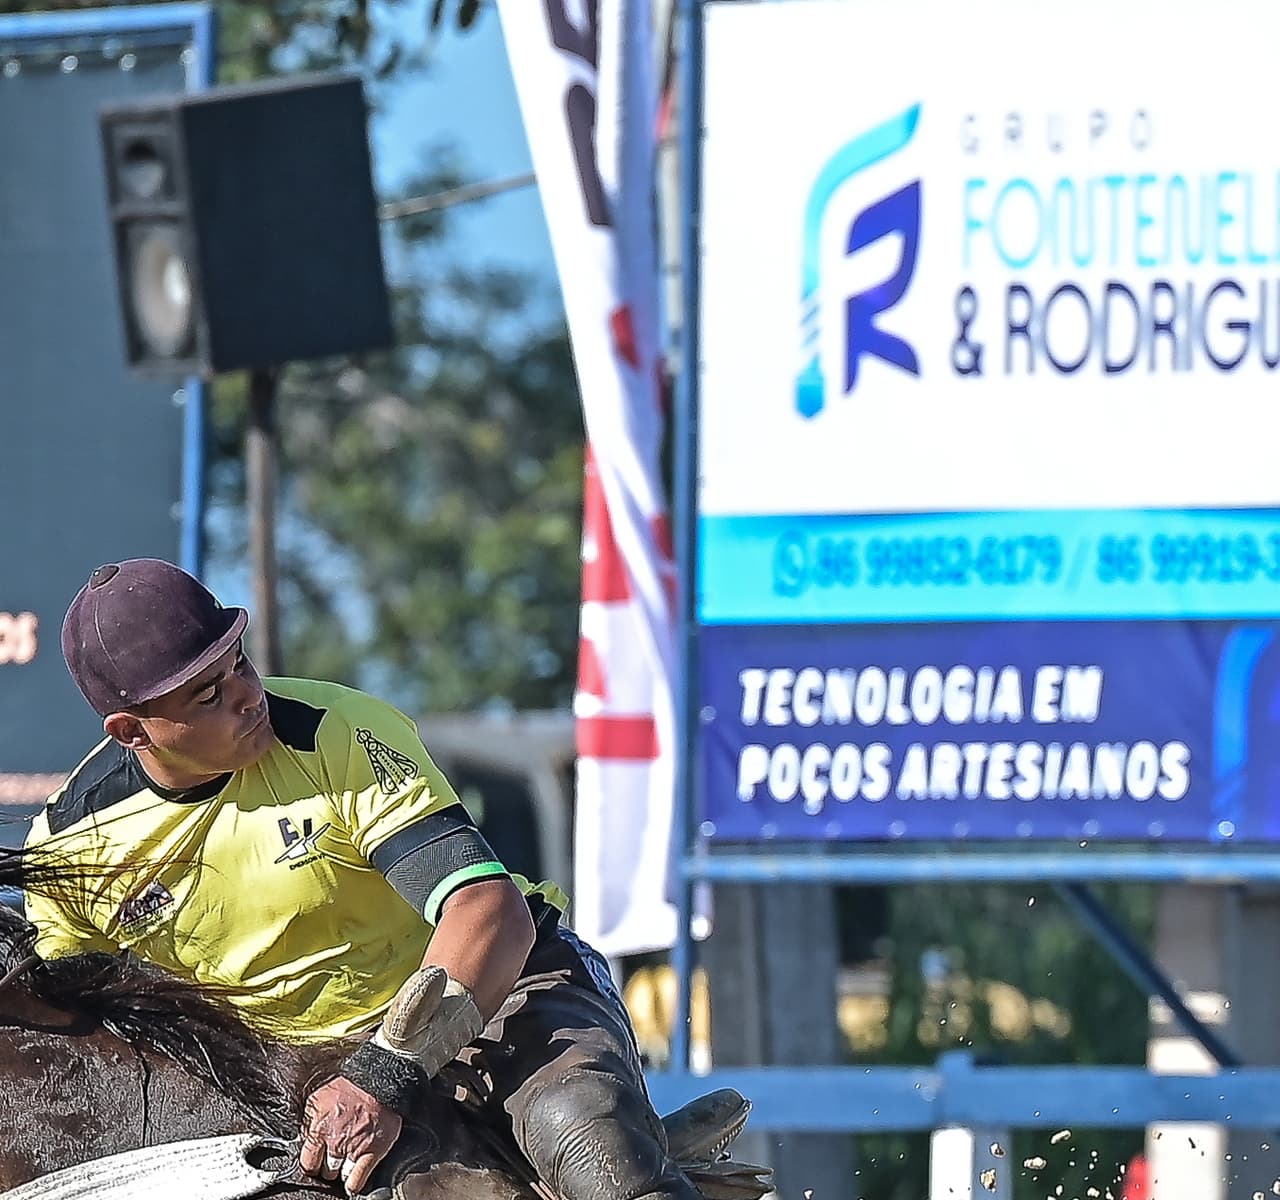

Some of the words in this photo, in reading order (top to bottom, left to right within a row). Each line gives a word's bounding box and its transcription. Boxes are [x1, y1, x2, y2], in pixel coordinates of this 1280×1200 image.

[958, 109, 1155, 154] GRUPO
[950, 282, 985, 378] &
[819, 534, 860, 588] 86
[1095, 532, 1142, 585] 86
[738, 665, 1025, 726] TECNOLOGIA
[1030, 664, 1105, 725] EM
[737, 742, 893, 816] POÇOS
[896, 740, 1191, 802] ARTESIANOS
